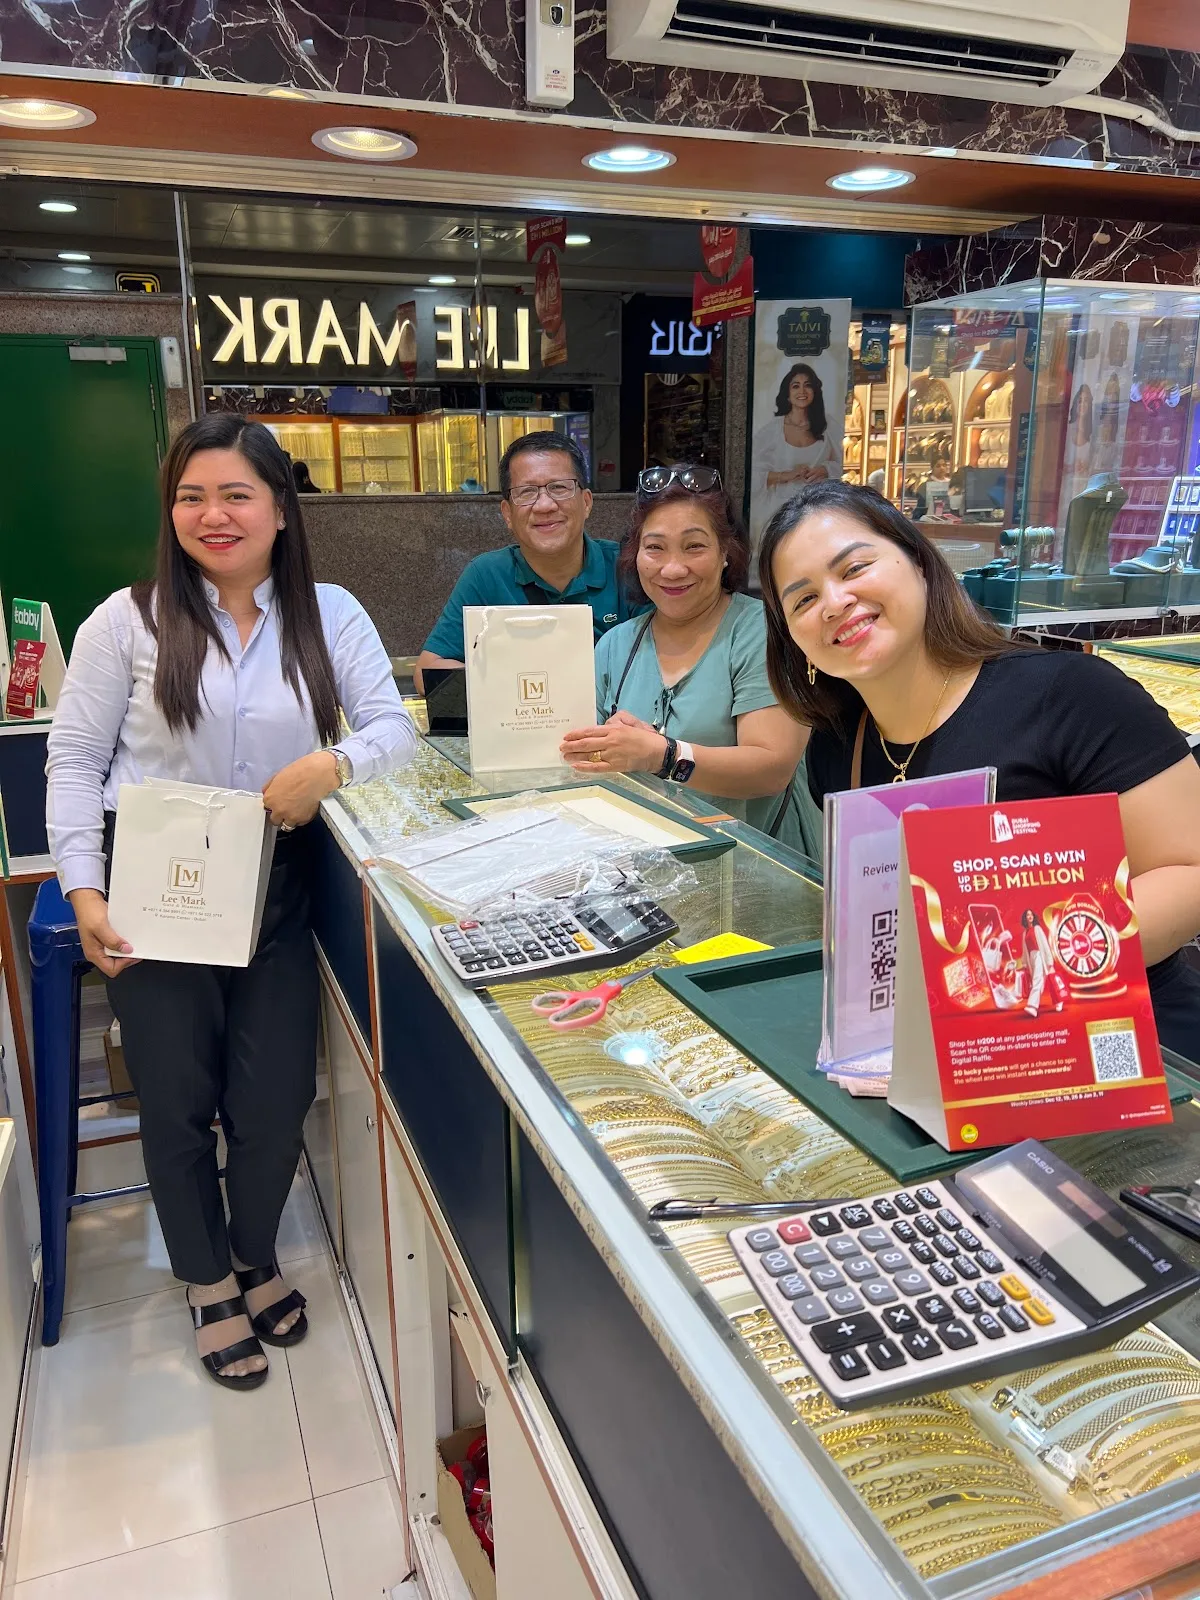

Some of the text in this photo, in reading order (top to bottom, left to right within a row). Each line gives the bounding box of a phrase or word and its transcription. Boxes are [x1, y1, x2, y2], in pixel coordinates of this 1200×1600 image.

[789, 323, 821, 333] TAJVI
[14, 606, 39, 630] tabby
[515, 706, 554, 716] Lee Mark
[953, 850, 1085, 873] SHOP, SCAN & WIN
[863, 861, 898, 877] Review
[958, 876, 970, 884] UP
[993, 867, 1085, 890] 1 MILLION
[959, 884, 972, 893] TO
[161, 894, 206, 906] Lee Mark
[949, 1041, 965, 1049] Shop
[1016, 1031, 1054, 1041] participating
[1007, 1042, 1030, 1050] in-store
[951, 1055, 993, 1065] Digital Raffle.
[964, 1068, 981, 1077] lucky
[983, 1065, 1008, 1073] winners
[1020, 1062, 1030, 1070] get
[1036, 1059, 1056, 1067] chance
[965, 1075, 982, 1083] wheel
[1044, 1065, 1072, 1074] rewards!
[1026, 1151, 1055, 1175] CASIO
[919, 1189, 937, 1204] DISP
[850, 1207, 868, 1219] AC
[787, 1224, 803, 1234] C
[896, 1221, 912, 1236] M+
[753, 1232, 770, 1242] 0
[866, 1231, 886, 1239] 7
[836, 1241, 853, 1250] 4
[936, 1234, 957, 1252] INSERT
[803, 1248, 820, 1257] 1
[883, 1253, 902, 1262] 8
[767, 1252, 788, 1272] 00
[851, 1261, 871, 1271] 5
[956, 1254, 977, 1275] DELETE
[817, 1270, 837, 1280] 2
[932, 1262, 954, 1281] MRC
[783, 1274, 806, 1293] 000
[902, 1274, 921, 1284] 9
[869, 1284, 888, 1293] 6
[835, 1292, 854, 1303] 3
[957, 1289, 977, 1305] MU
[980, 1315, 999, 1329] GT
